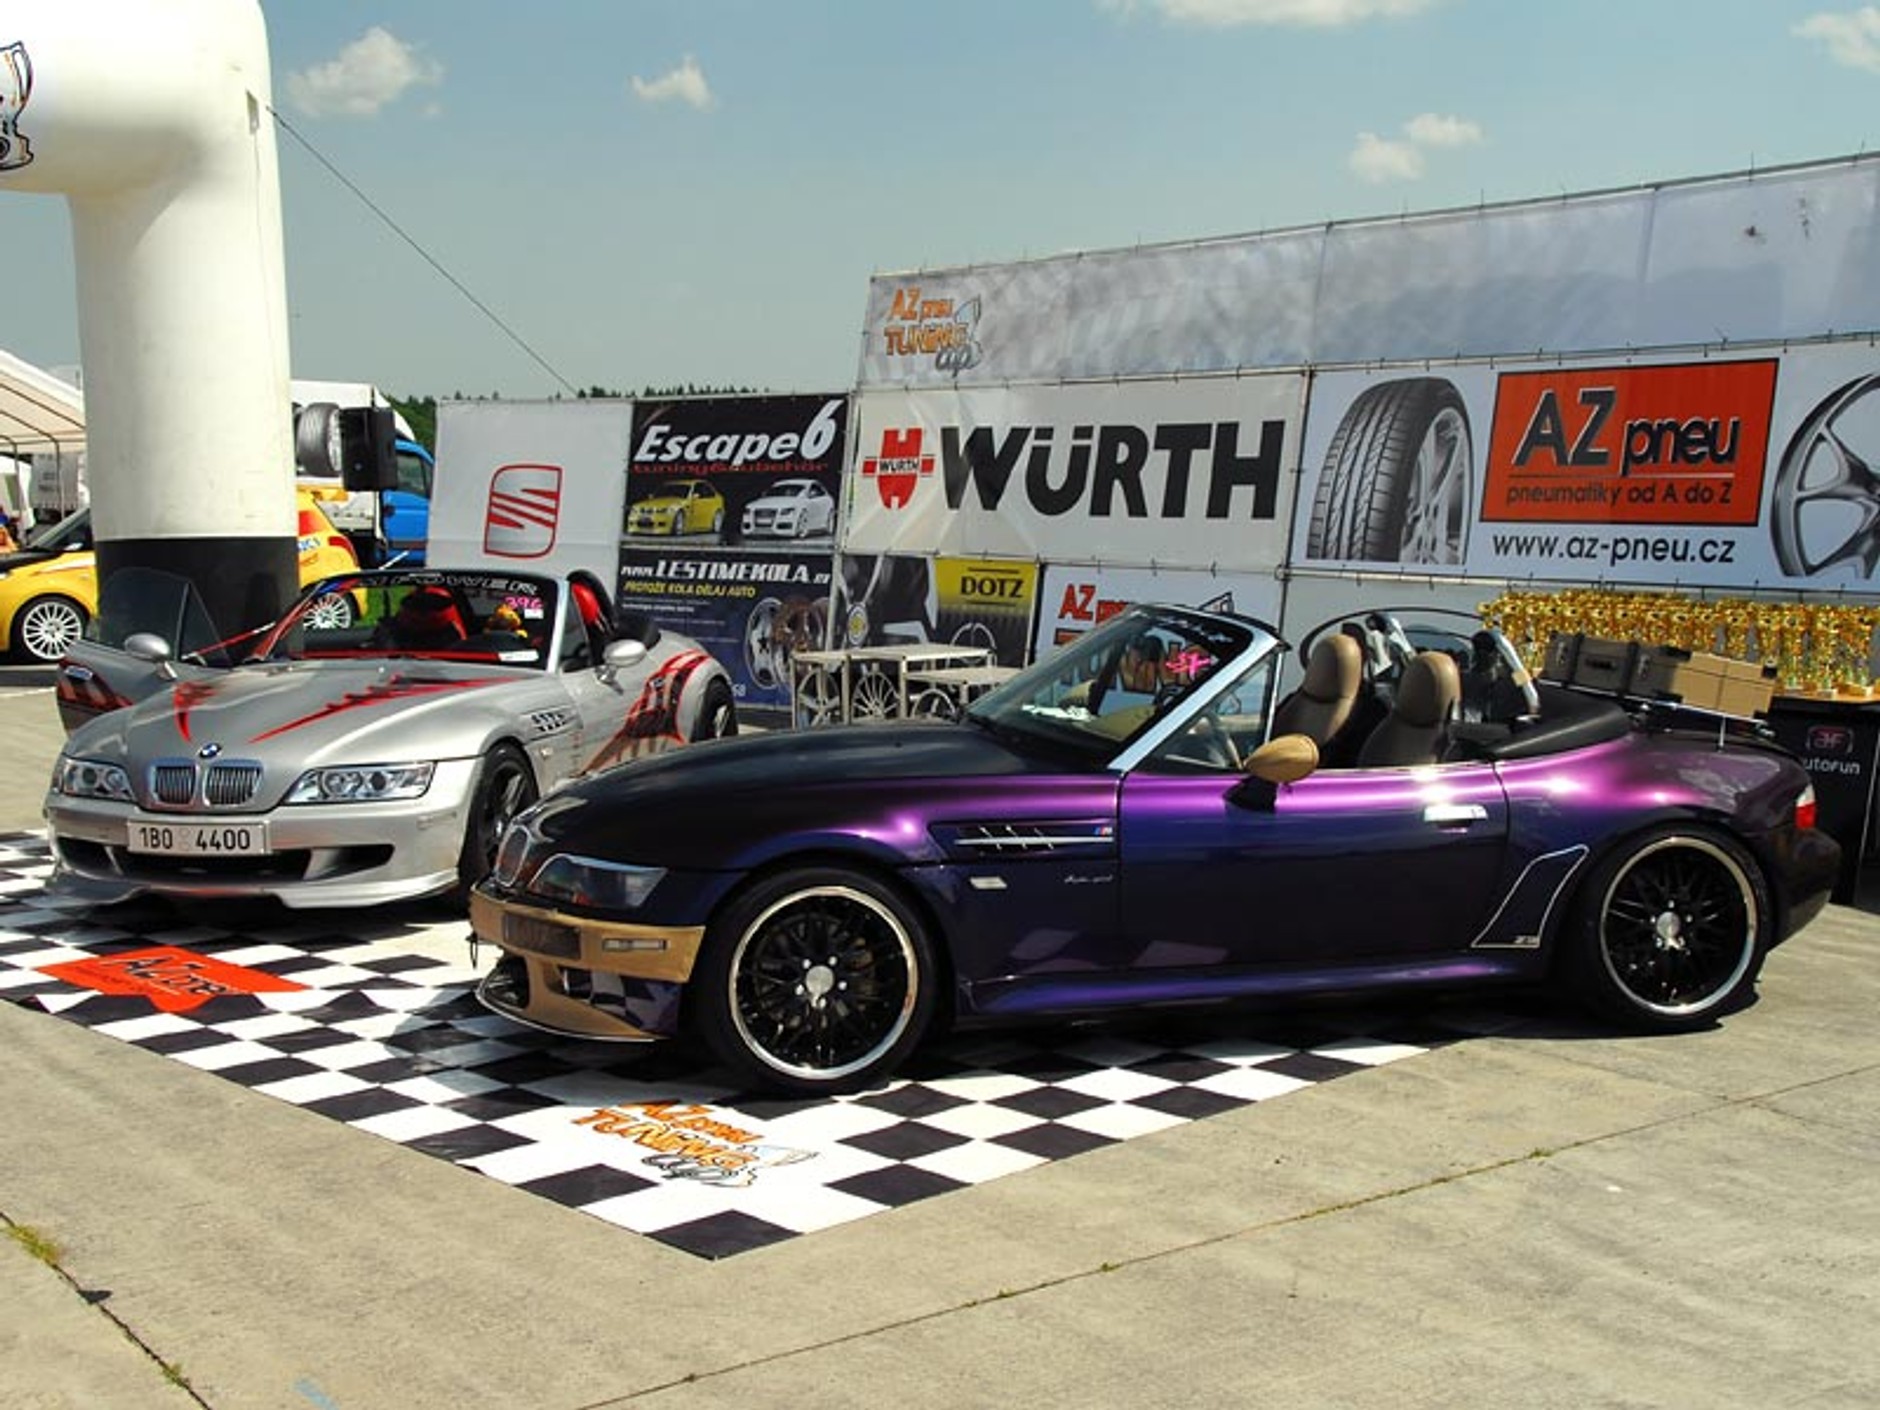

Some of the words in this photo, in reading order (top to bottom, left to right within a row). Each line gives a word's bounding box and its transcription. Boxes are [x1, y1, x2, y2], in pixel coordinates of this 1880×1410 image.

[887, 287, 921, 320] AZ
[634, 400, 844, 466] Escape6
[1511, 385, 1616, 466] AZ
[1620, 416, 1740, 477] pneu
[941, 420, 1286, 519] WÜRTH
[1507, 484, 1622, 507] pneumatiky
[1627, 483, 1655, 504] od
[1662, 483, 1683, 503] A
[1685, 483, 1713, 504] do
[1718, 483, 1734, 504] Z
[1493, 534, 1736, 567] www.az-pneu.cz
[961, 576, 1024, 598] DOTZ
[1057, 583, 1096, 621] AZ
[196, 829, 250, 850] 4400
